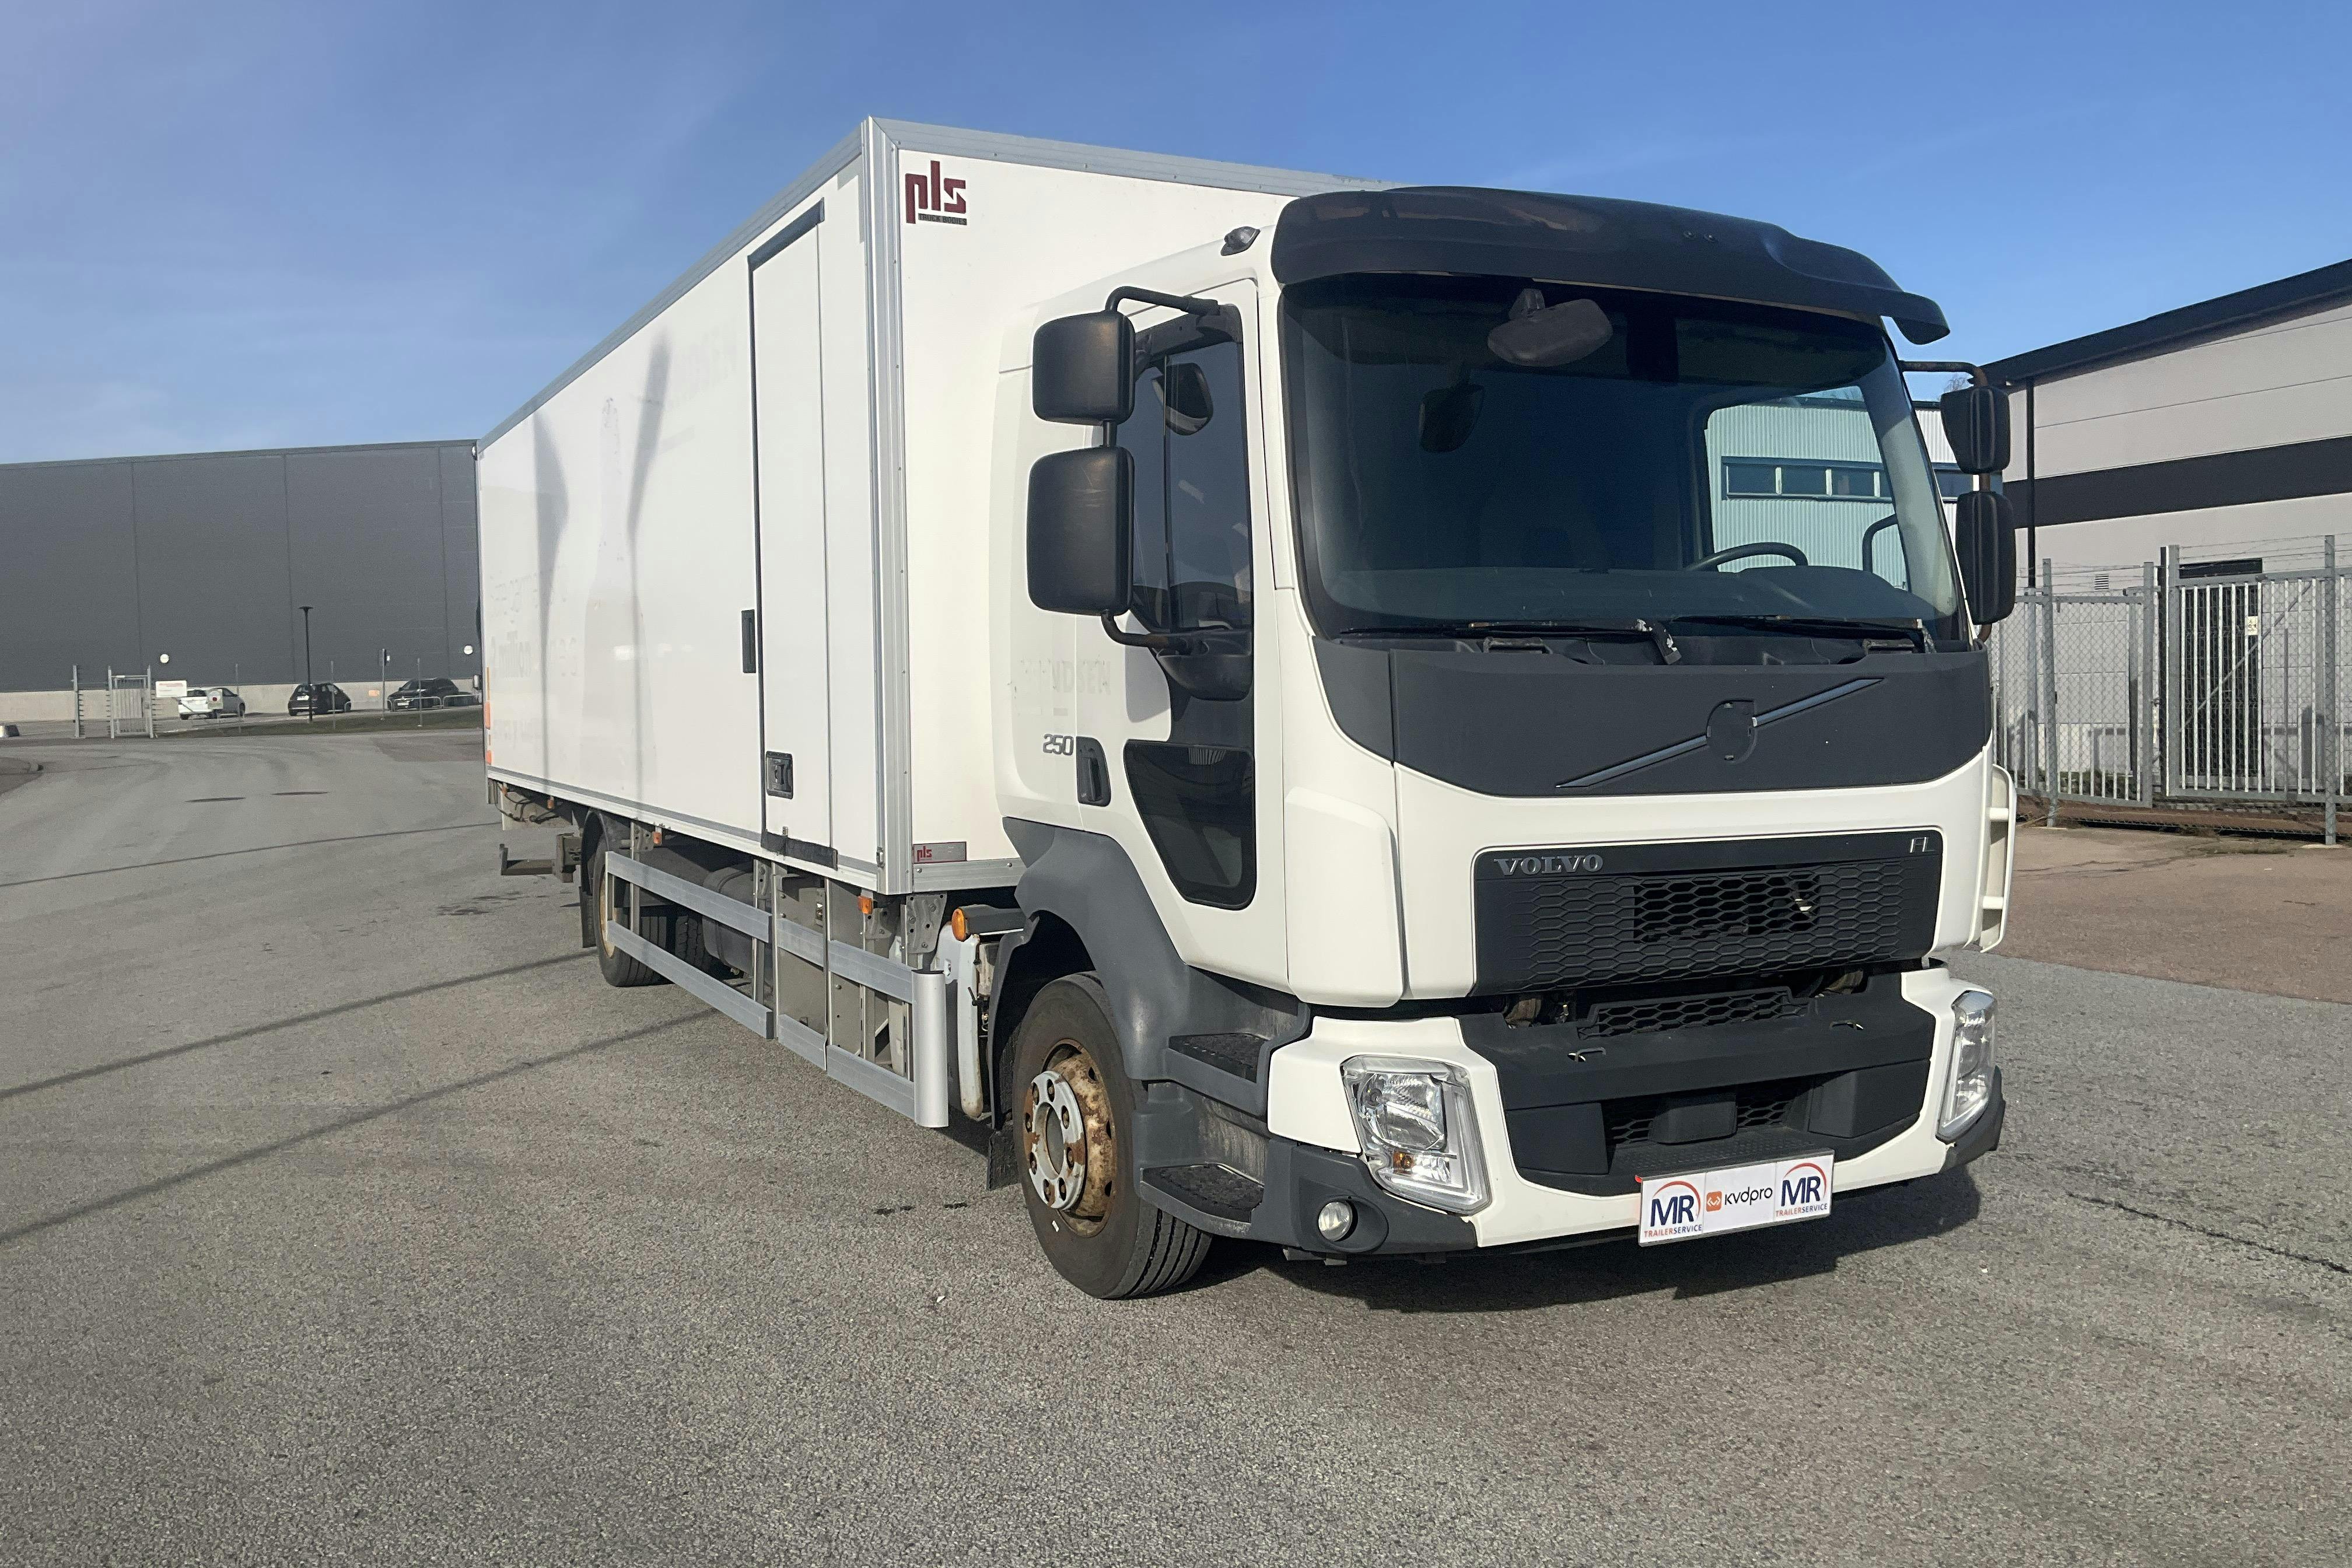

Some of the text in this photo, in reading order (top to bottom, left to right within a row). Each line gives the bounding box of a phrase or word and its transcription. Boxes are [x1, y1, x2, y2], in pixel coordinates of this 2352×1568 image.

[905, 160, 966, 224] pls
[1043, 734, 1074, 755] 250
[917, 846, 932, 862] pls
[1494, 854, 1604, 876] VOLVO
[1781, 1176, 1821, 1206] MR
[1650, 1195, 1694, 1227] MR
[1776, 1203, 1828, 1217] TRAILERSERVICE
[1644, 1224, 1702, 1238] TRAILERSERVICE
